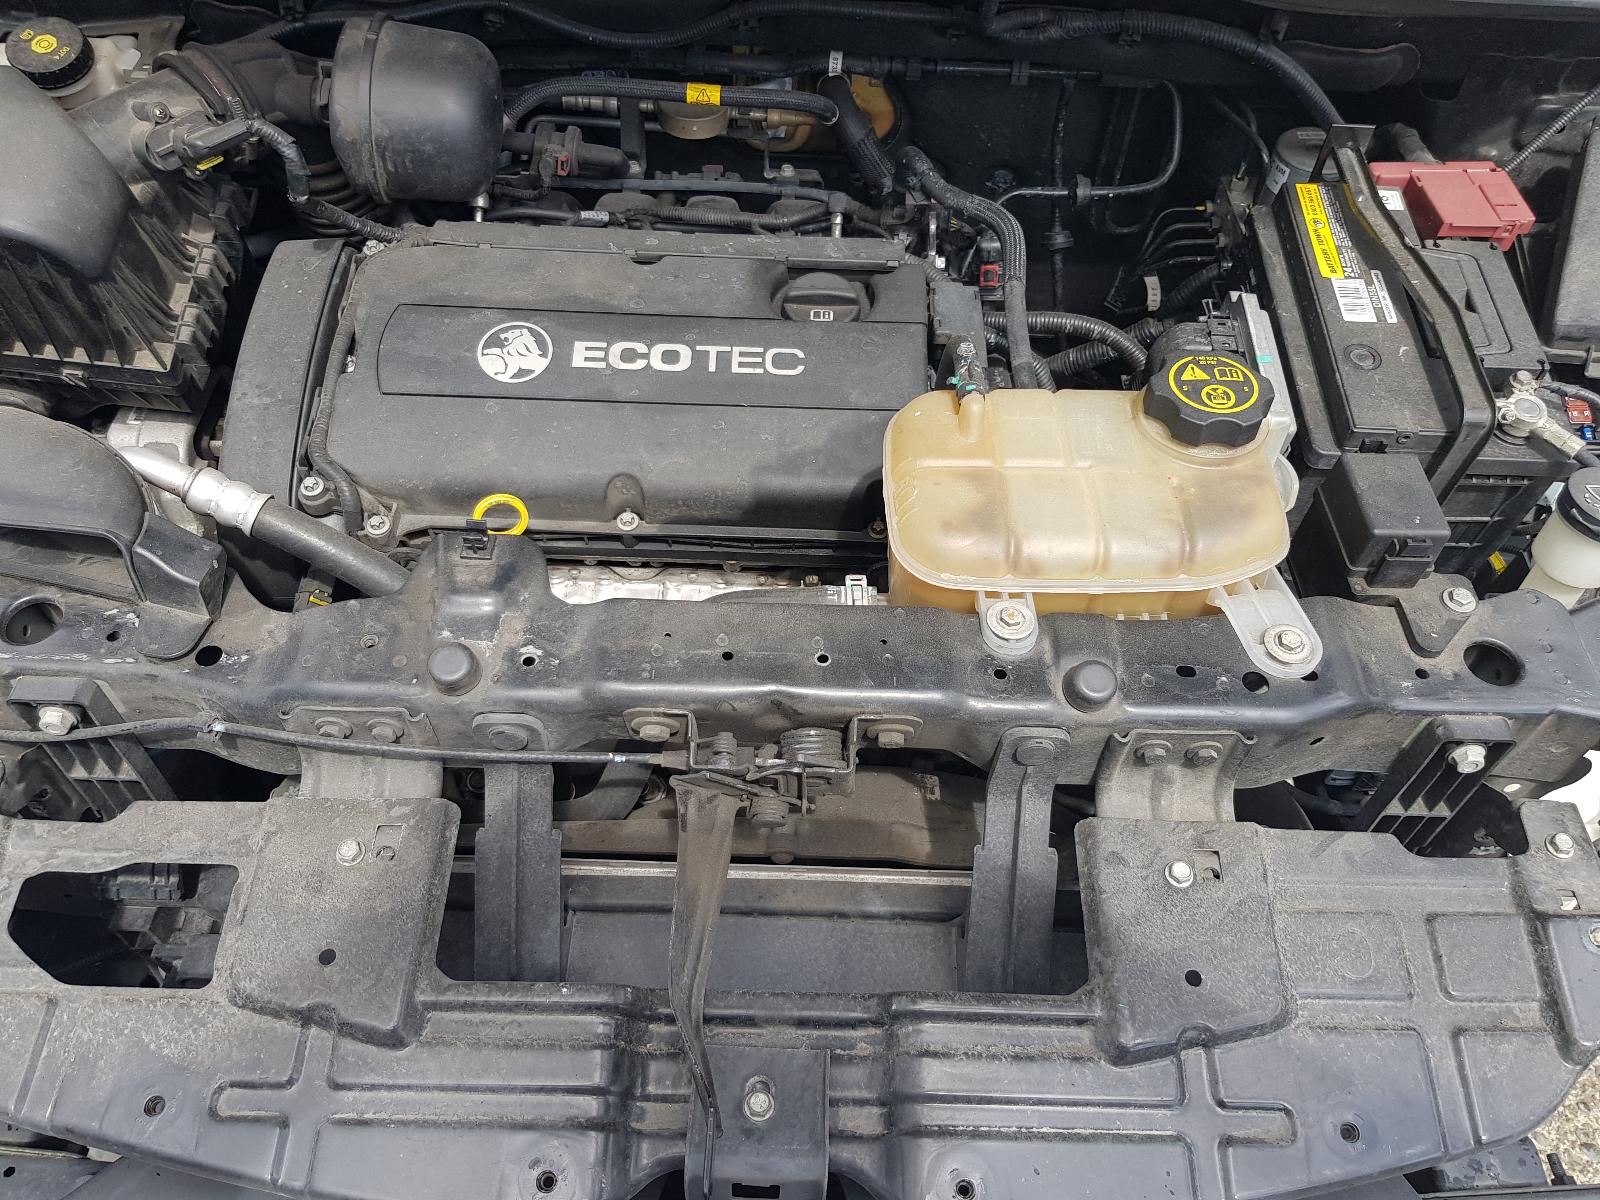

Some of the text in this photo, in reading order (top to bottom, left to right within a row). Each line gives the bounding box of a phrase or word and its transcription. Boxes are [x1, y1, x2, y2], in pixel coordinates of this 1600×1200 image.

[1312, 228, 1325, 246] TOWN
[1321, 247, 1337, 274] BATTERY
[1367, 285, 1382, 308] DIN55L
[571, 340, 806, 376] ECOTEC
